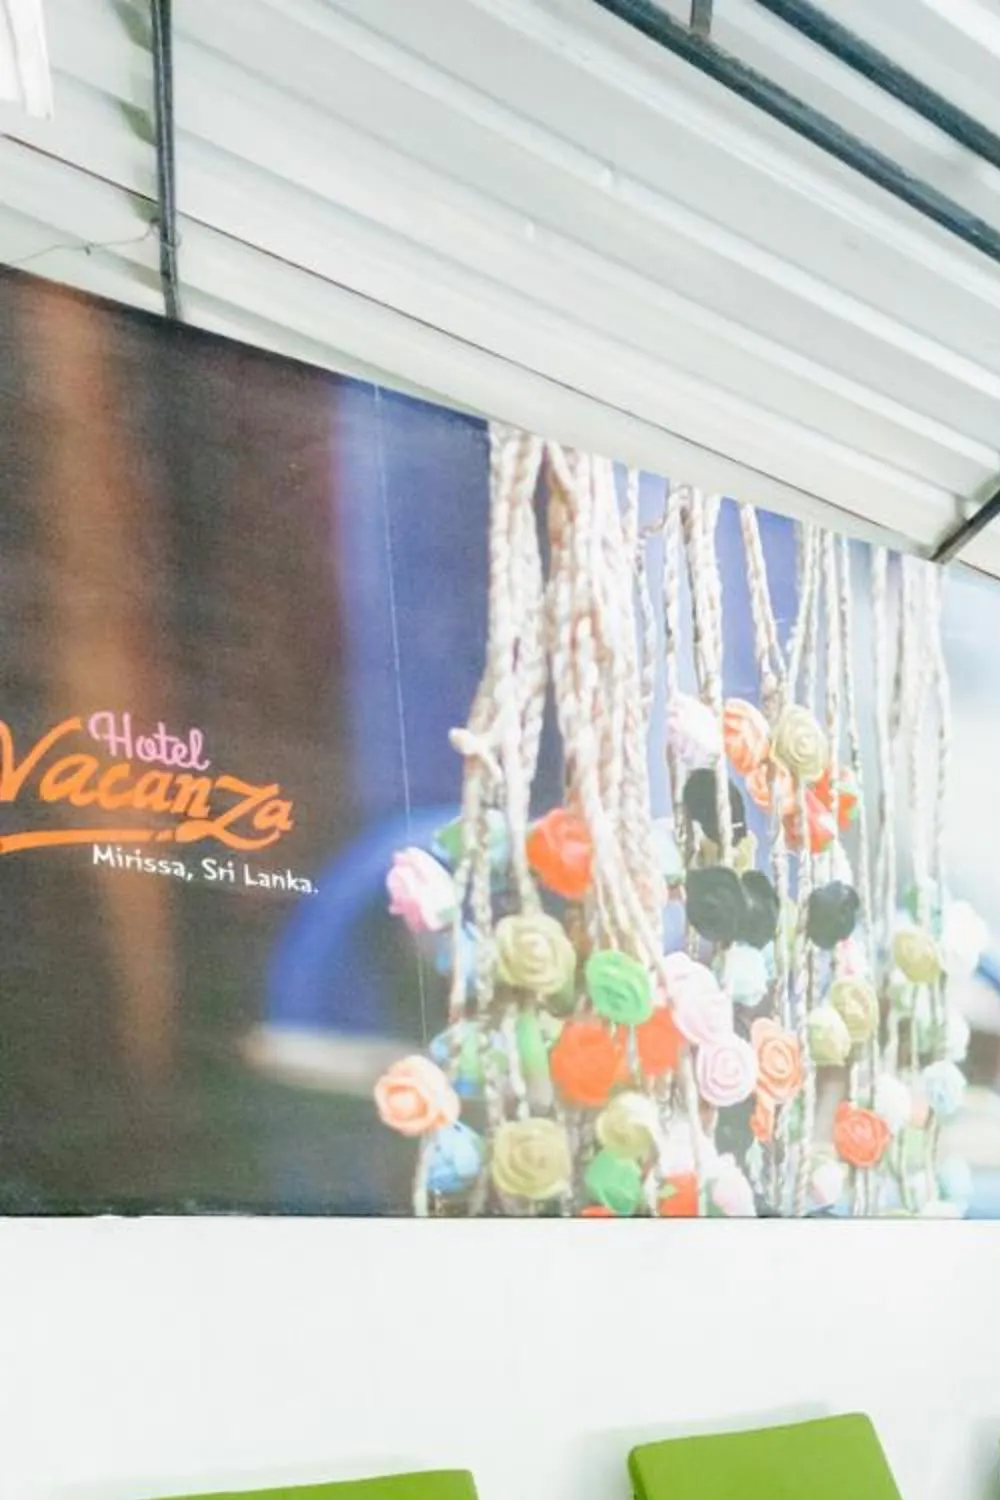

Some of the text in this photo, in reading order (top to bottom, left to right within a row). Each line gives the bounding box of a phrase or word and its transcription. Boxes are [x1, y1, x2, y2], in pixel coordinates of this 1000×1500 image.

[88, 711, 211, 770] Hotel
[92, 844, 319, 894] Mirissa, Sri Lanka.
